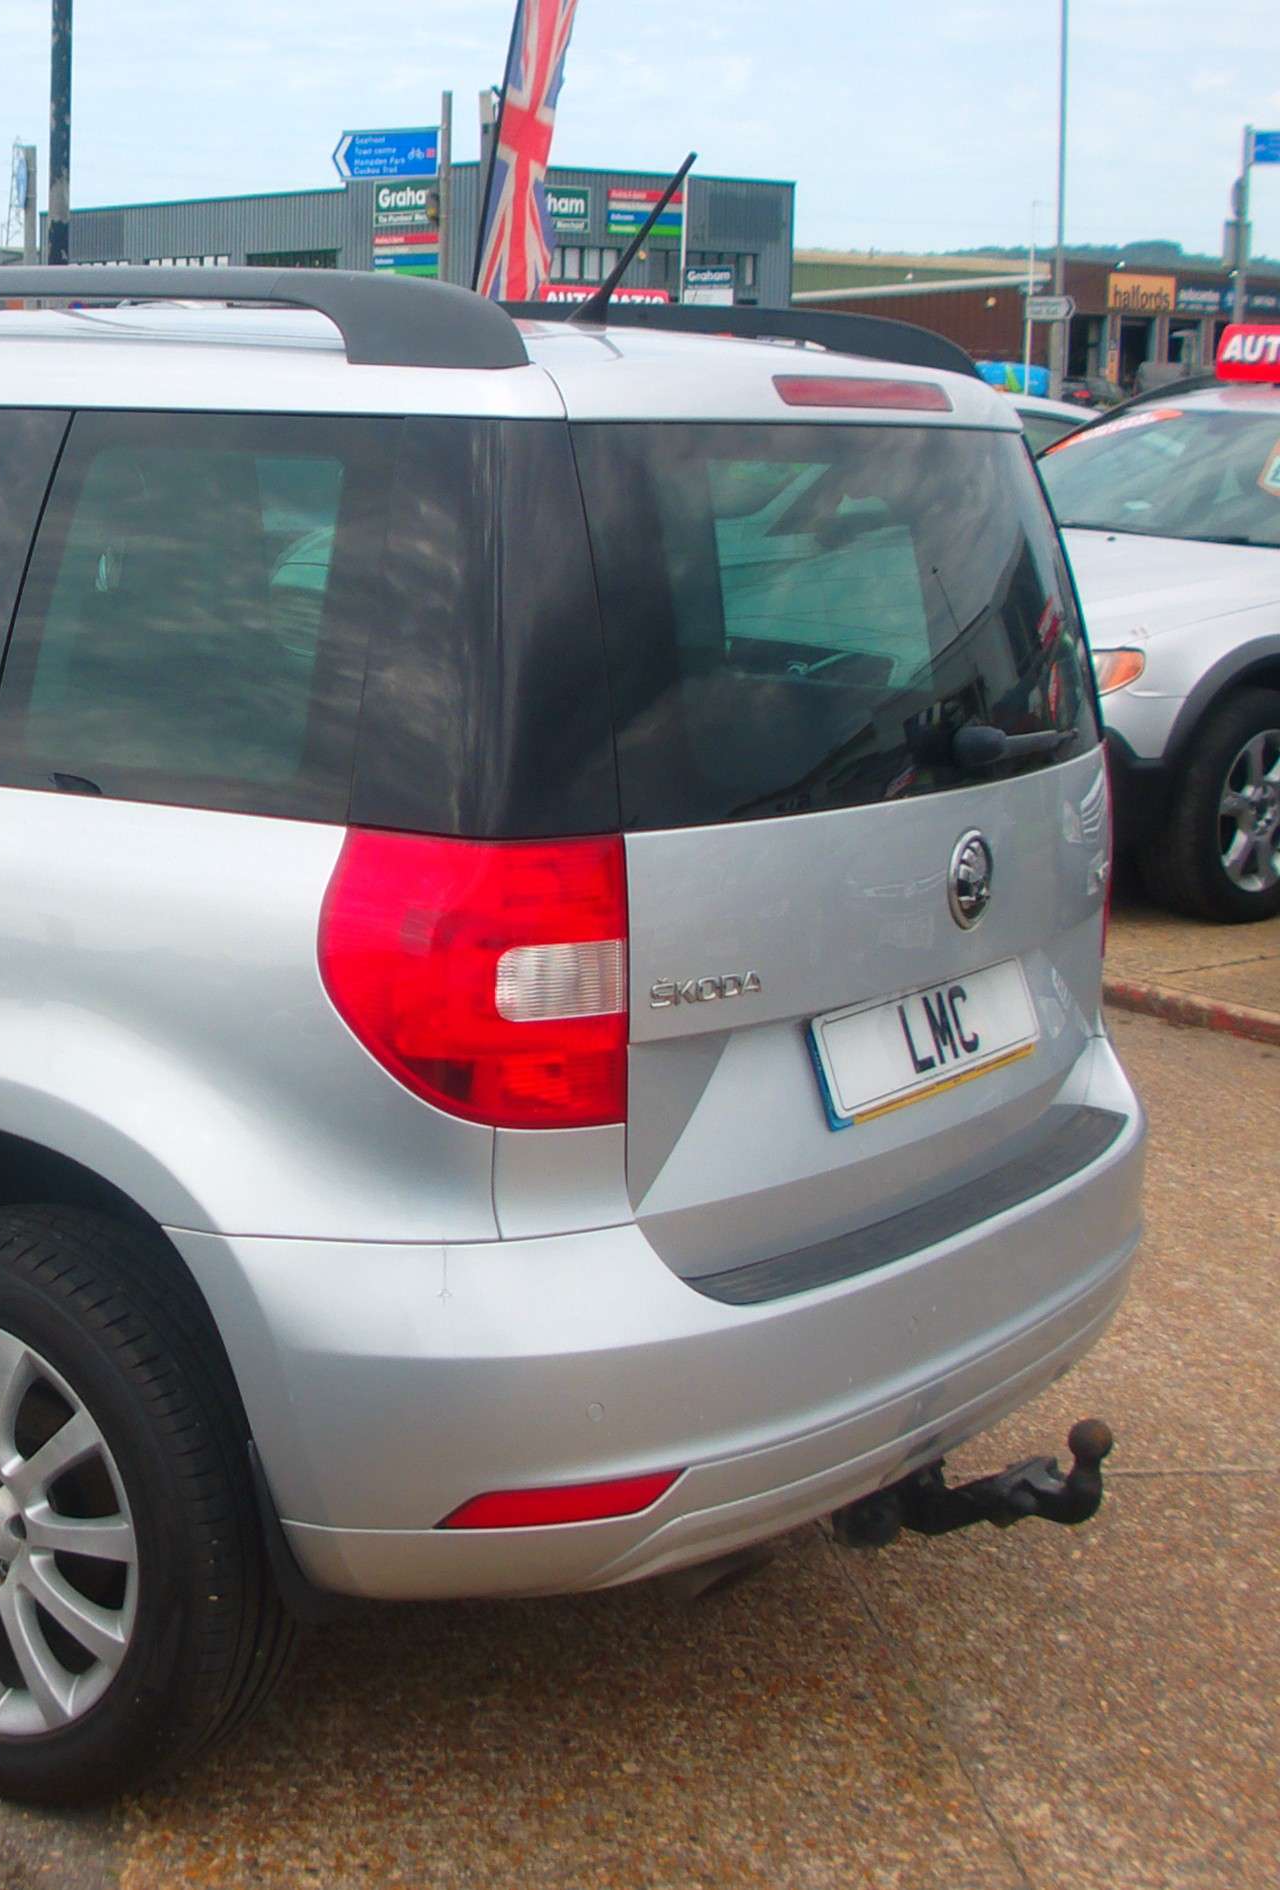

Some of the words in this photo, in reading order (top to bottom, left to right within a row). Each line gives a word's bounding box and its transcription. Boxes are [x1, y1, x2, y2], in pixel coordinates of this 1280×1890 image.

[378, 186, 430, 209] Graha
[547, 192, 585, 214] ham
[1113, 283, 1170, 308] halfords
[651, 969, 761, 1007] ŠKODA
[897, 985, 979, 1074] LMC
